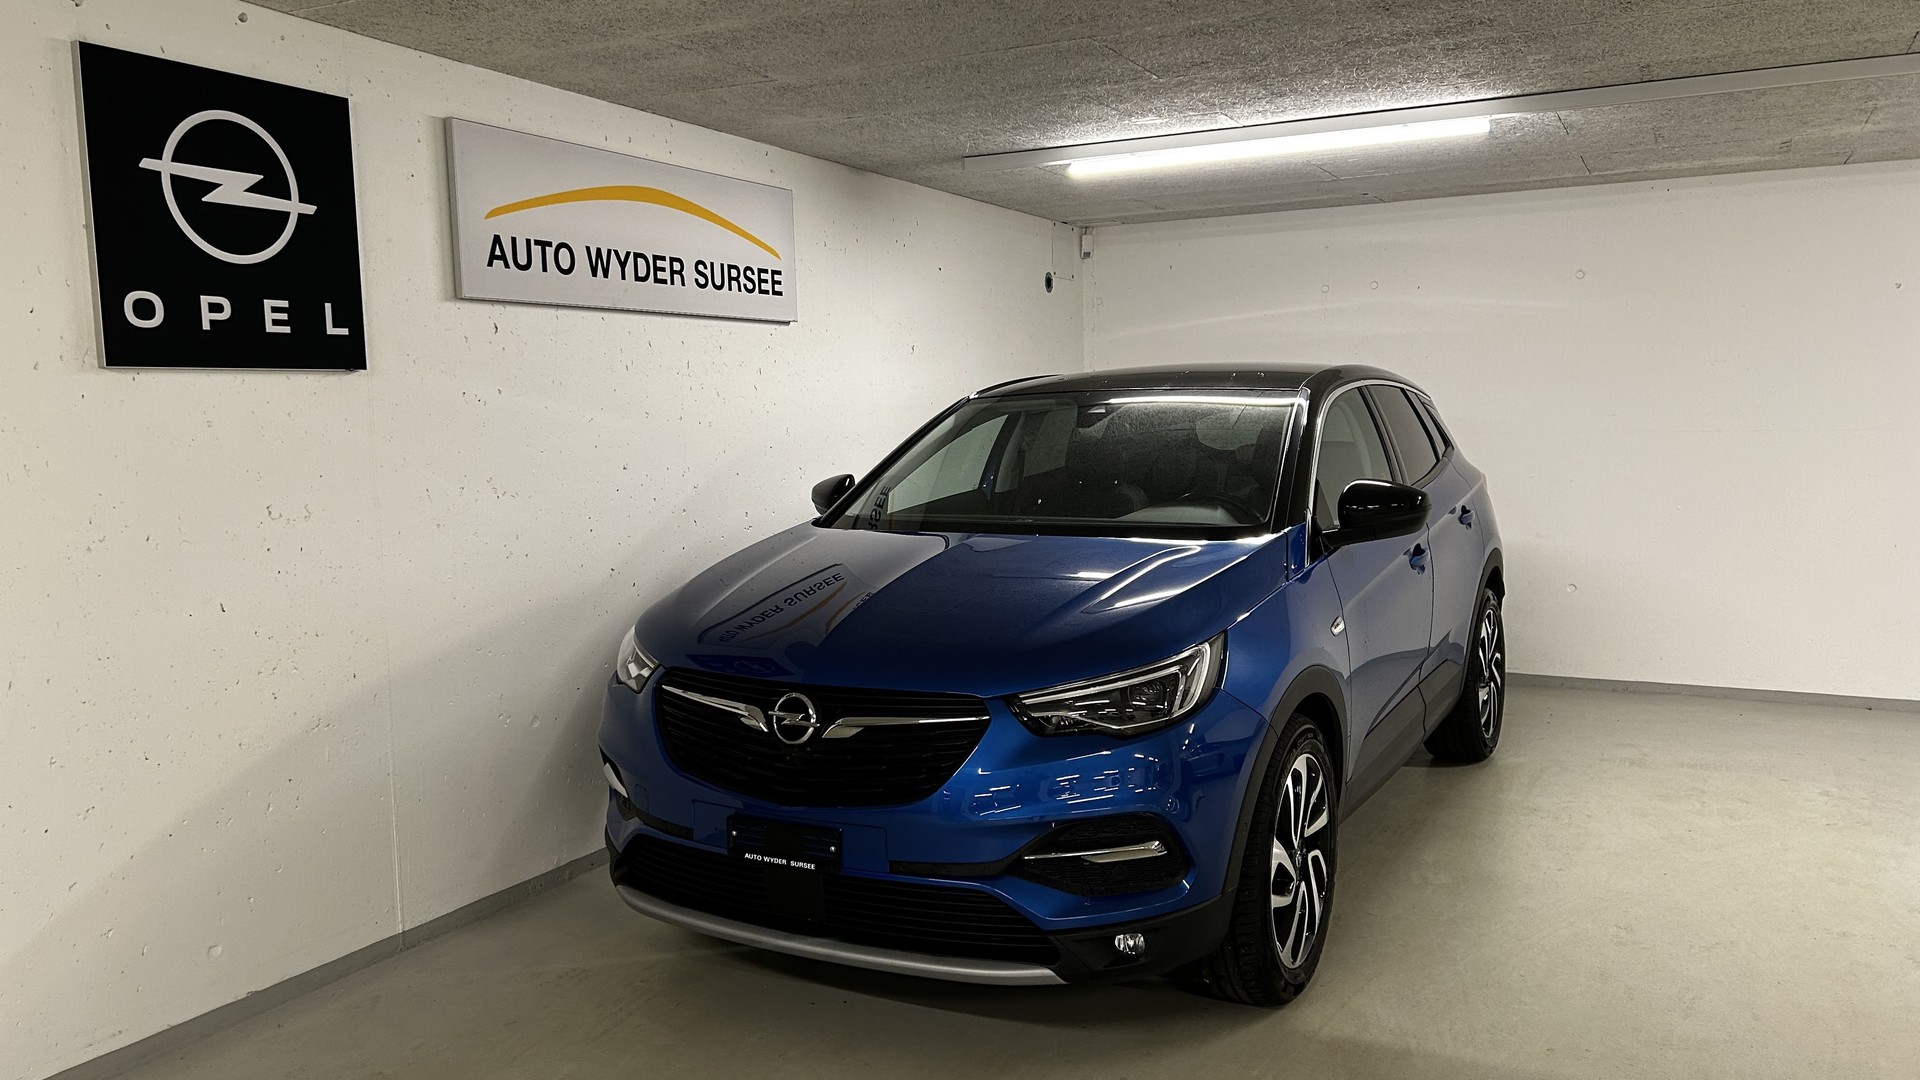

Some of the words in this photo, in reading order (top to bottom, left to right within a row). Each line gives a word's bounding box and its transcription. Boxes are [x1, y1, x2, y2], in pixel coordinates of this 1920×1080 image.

[486, 233, 577, 276] AUTO
[585, 244, 687, 288] WYDER
[694, 258, 784, 298] SURSEE
[123, 290, 350, 336] OPEL
[744, 852, 762, 861] AUTO
[763, 855, 787, 866] WYDER
[790, 860, 816, 870] SURSEE
